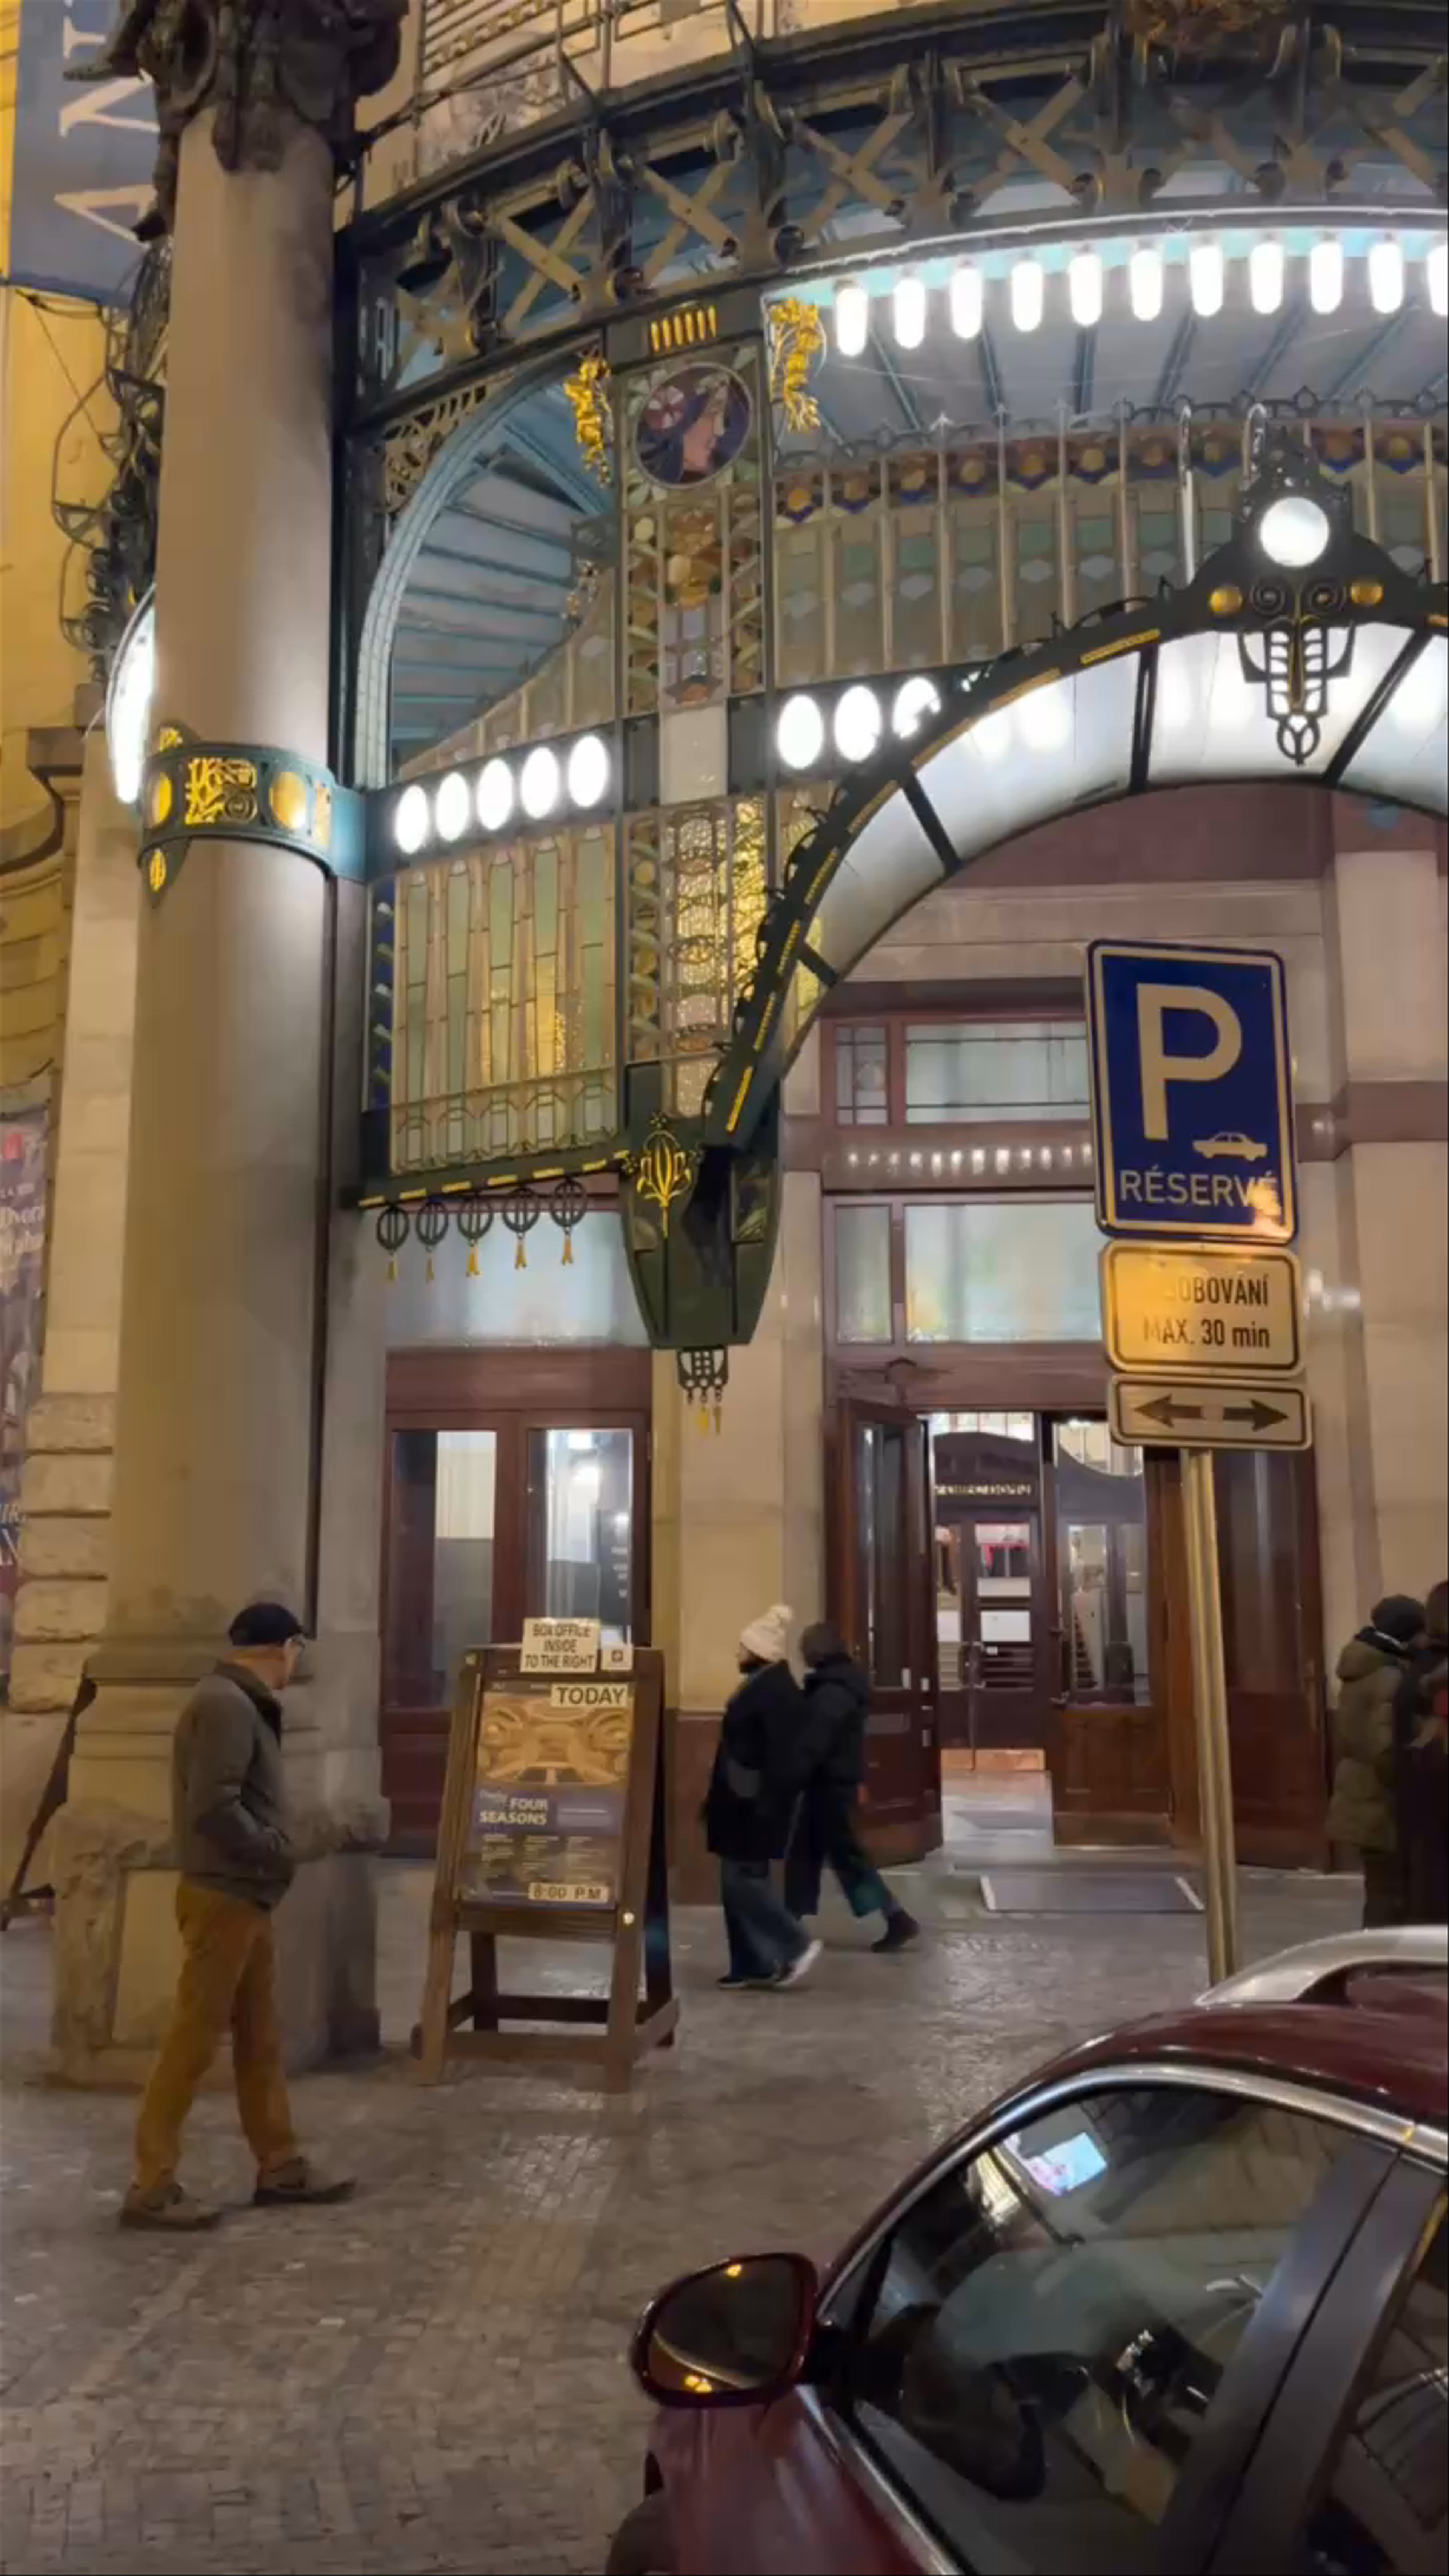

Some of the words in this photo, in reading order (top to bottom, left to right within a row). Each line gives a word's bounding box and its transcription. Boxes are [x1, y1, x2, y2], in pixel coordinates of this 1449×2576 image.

[1137, 983, 1243, 1140] P
[1165, 1273, 1269, 1307] OBOVÁNÍ
[1201, 1319, 1225, 1346] 30
[1232, 1321, 1270, 1348] min
[532, 1623, 552, 1637] BOX
[525, 1655, 538, 1668] TO
[540, 1655, 560, 1668] THE
[562, 1655, 594, 1668] RIGHT
[556, 1687, 625, 1705] TODAY
[509, 1797, 548, 1811] FOUR
[480, 1810, 547, 1826] SEASONS
